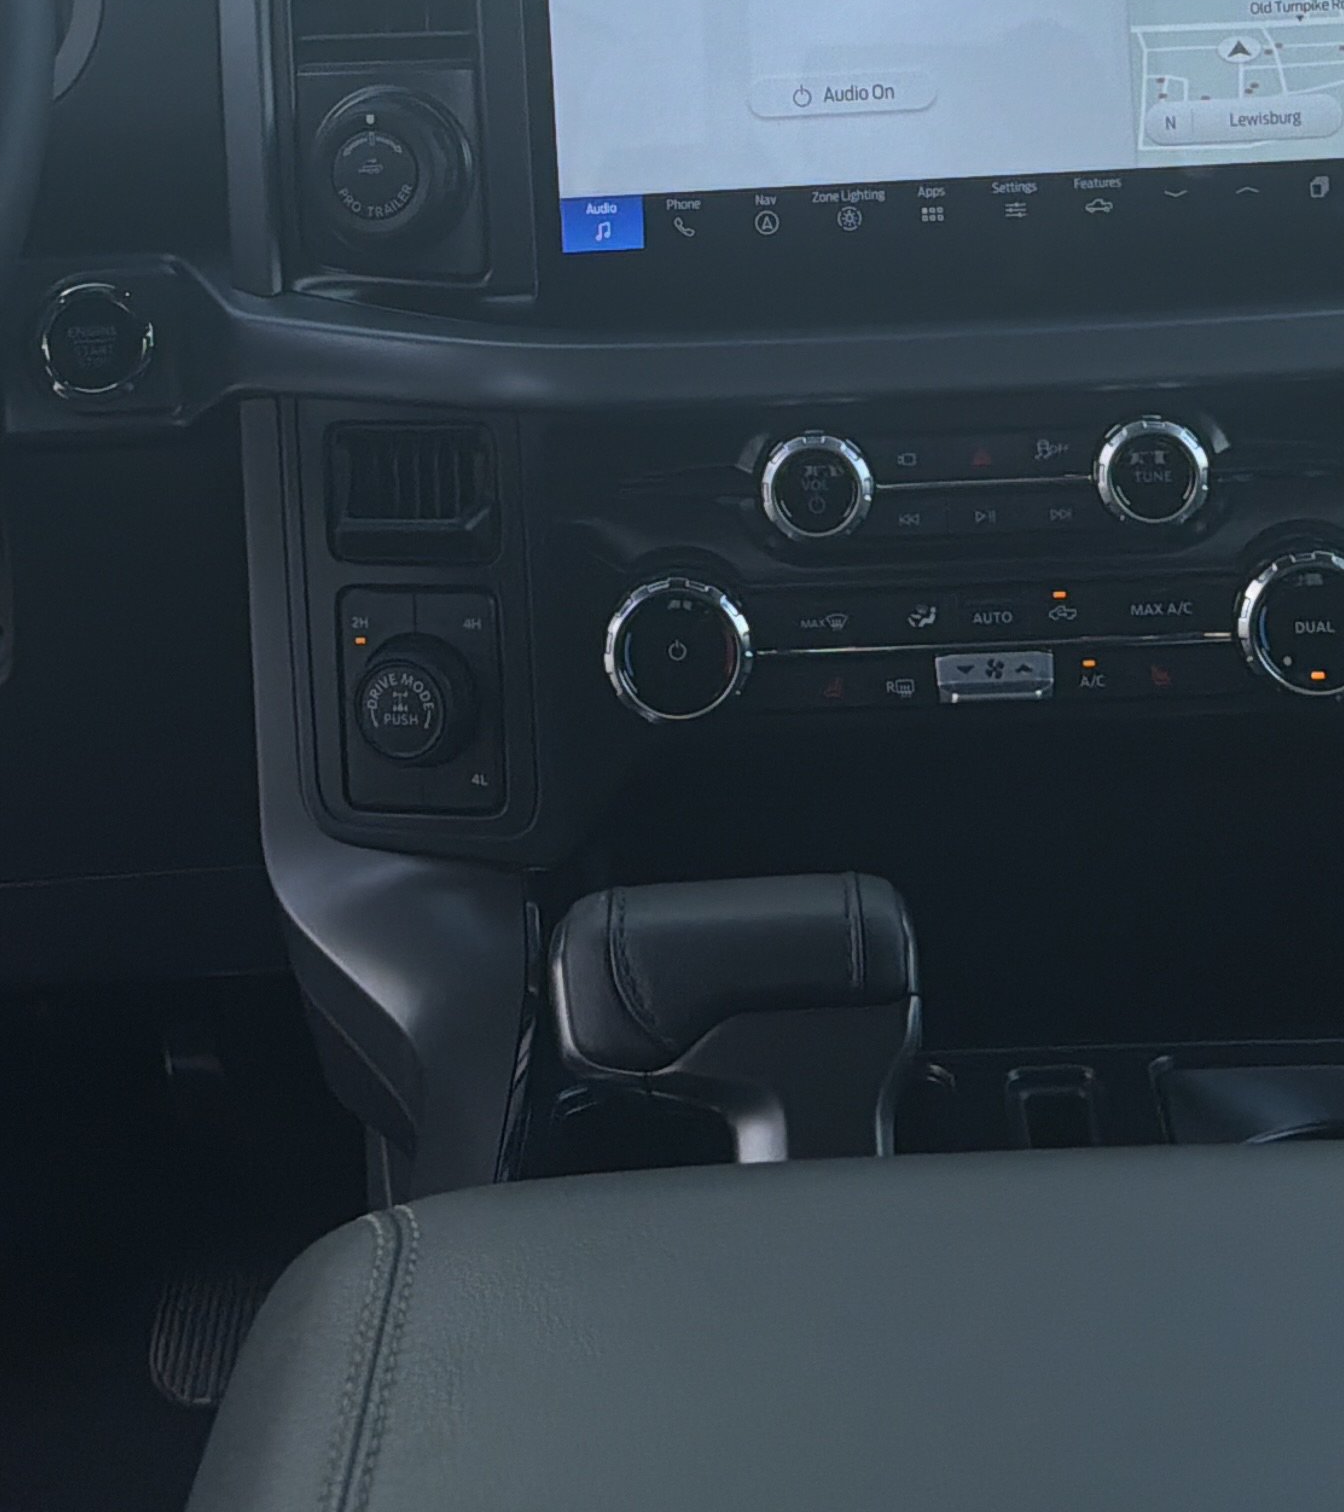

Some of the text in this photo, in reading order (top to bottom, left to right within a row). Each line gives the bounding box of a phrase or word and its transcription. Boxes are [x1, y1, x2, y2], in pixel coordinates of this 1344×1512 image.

[1249, 1, 1273, 14] Old
[823, 83, 895, 103] Audio On
[1165, 116, 1177, 130] N
[1229, 110, 1302, 128] Lewisburg
[992, 180, 1038, 195] Settings
[1073, 176, 1122, 190] Features
[811, 188, 886, 204] Zone Lighting
[918, 185, 945, 199] Apps
[338, 183, 413, 218] PRO TRAILER
[666, 198, 701, 211] Phone
[756, 195, 777, 206] Nav
[586, 202, 618, 215] Audio
[1135, 470, 1173, 483] TUNE
[1131, 600, 1193, 617] MAX A/C
[352, 617, 369, 629] 2H
[463, 618, 481, 630] 4H
[800, 620, 826, 629] MAX
[973, 611, 1013, 624] AUTO
[1295, 620, 1336, 634] DUAL
[1080, 673, 1106, 689] A/C
[367, 673, 435, 710] DRIVE MODE
[383, 713, 419, 726] PUSH
[471, 774, 488, 786] 4L
